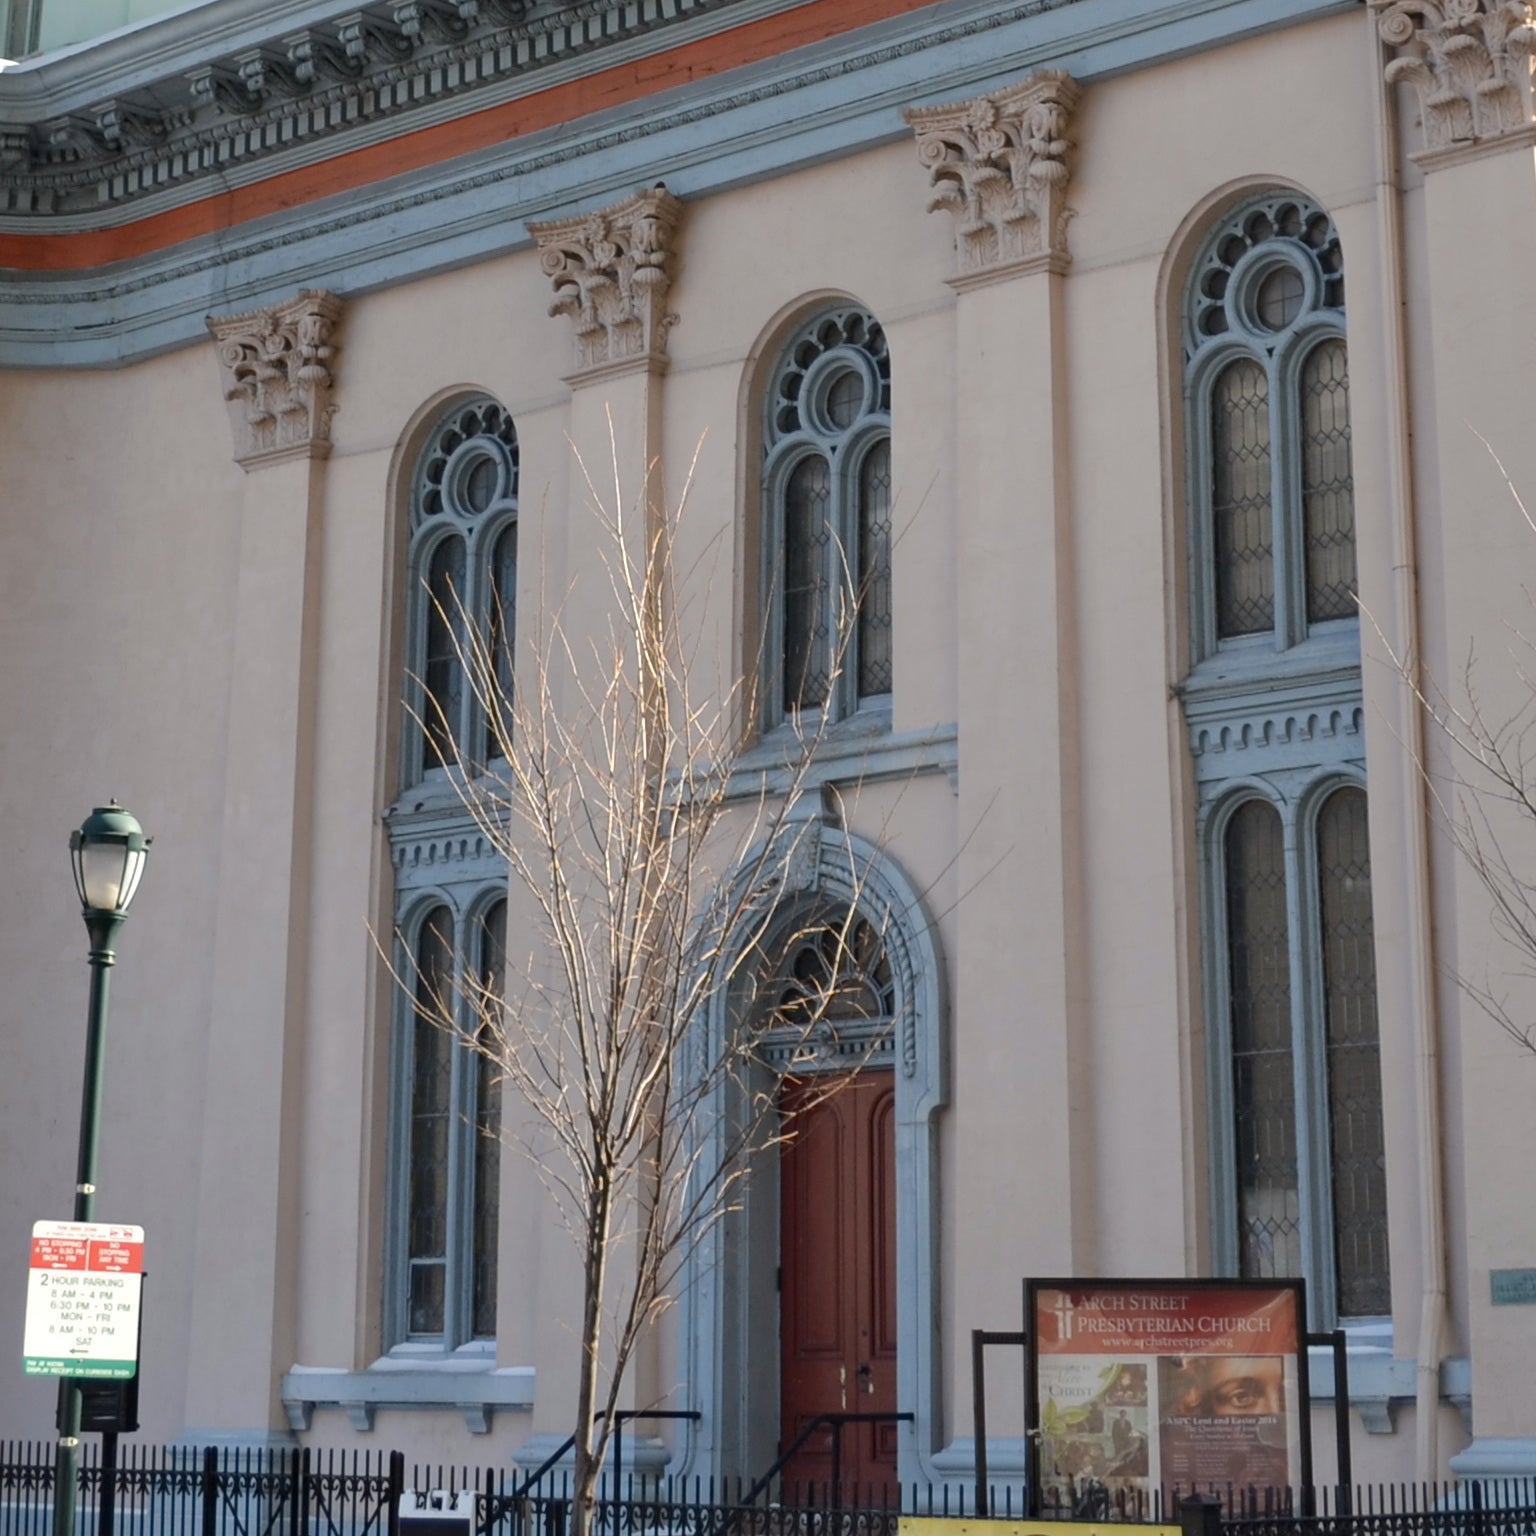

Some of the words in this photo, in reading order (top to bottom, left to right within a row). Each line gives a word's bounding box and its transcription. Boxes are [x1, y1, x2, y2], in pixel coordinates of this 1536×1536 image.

[40, 1273, 49, 1286] 2
[52, 1276, 79, 1285] HOUR
[83, 1277, 124, 1288] PARKING
[51, 1289, 57, 1298] 8
[61, 1290, 76, 1298] AM
[89, 1291, 95, 1299] 4
[99, 1291, 113, 1299] PM
[50, 1301, 72, 1310] 6:30
[75, 1302, 90, 1310] PM
[103, 1303, 113, 1311] 10
[117, 1304, 131, 1312] PM
[1078, 1296, 1125, 1311] ARCH
[1129, 1295, 1189, 1310] STREET
[61, 1312, 83, 1321] MON
[96, 1313, 111, 1322] FRI
[1077, 1316, 1194, 1332] PRESBYTERIAN
[1197, 1316, 1271, 1332] CHURCH
[48, 1325, 55, 1333] 8
[59, 1325, 74, 1333] AM
[87, 1326, 97, 1335] 10
[101, 1326, 115, 1335] PM
[75, 1337, 93, 1346] SAT
[1049, 1385, 1092, 1397] CHRIST
